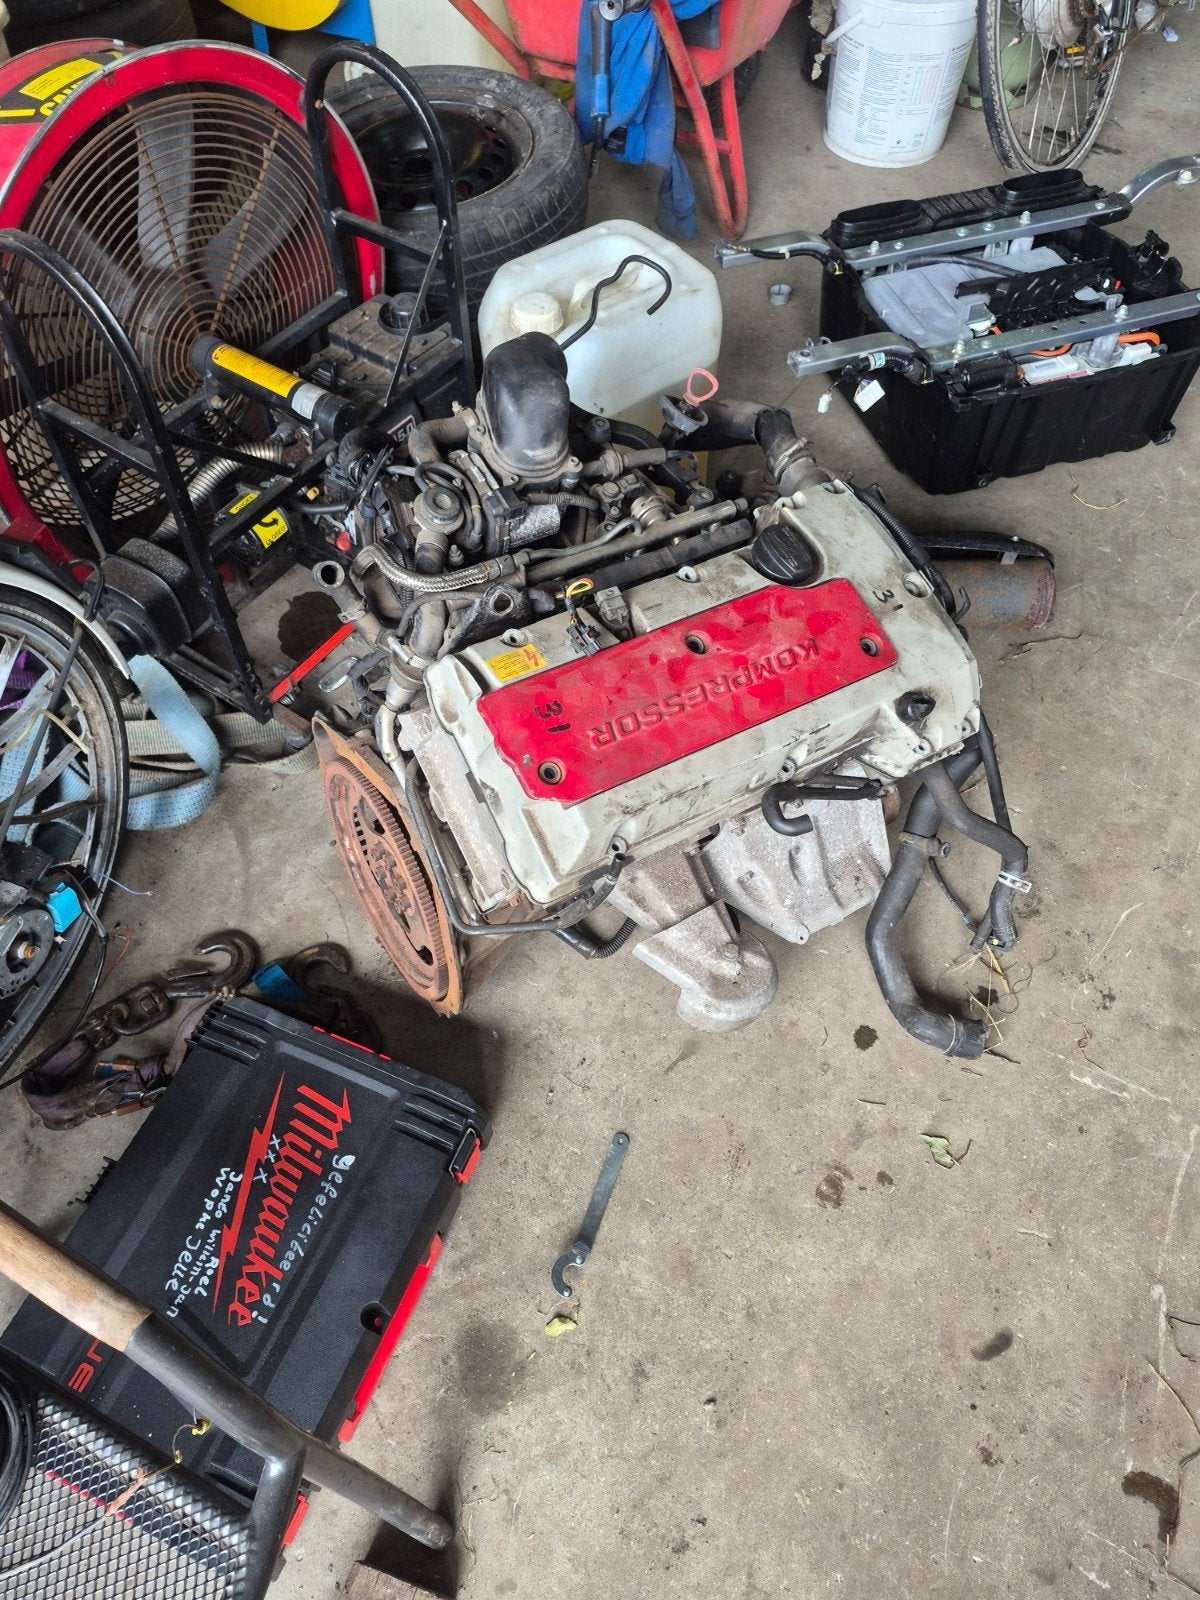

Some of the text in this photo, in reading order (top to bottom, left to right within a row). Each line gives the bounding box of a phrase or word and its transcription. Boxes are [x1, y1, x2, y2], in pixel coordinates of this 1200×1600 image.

[586, 637, 821, 751] KOMPRESSOR
[228, 1085, 351, 1327] Milwaukee
[165, 1235, 201, 1290] Jelle
[194, 1256, 219, 1297] Roel
